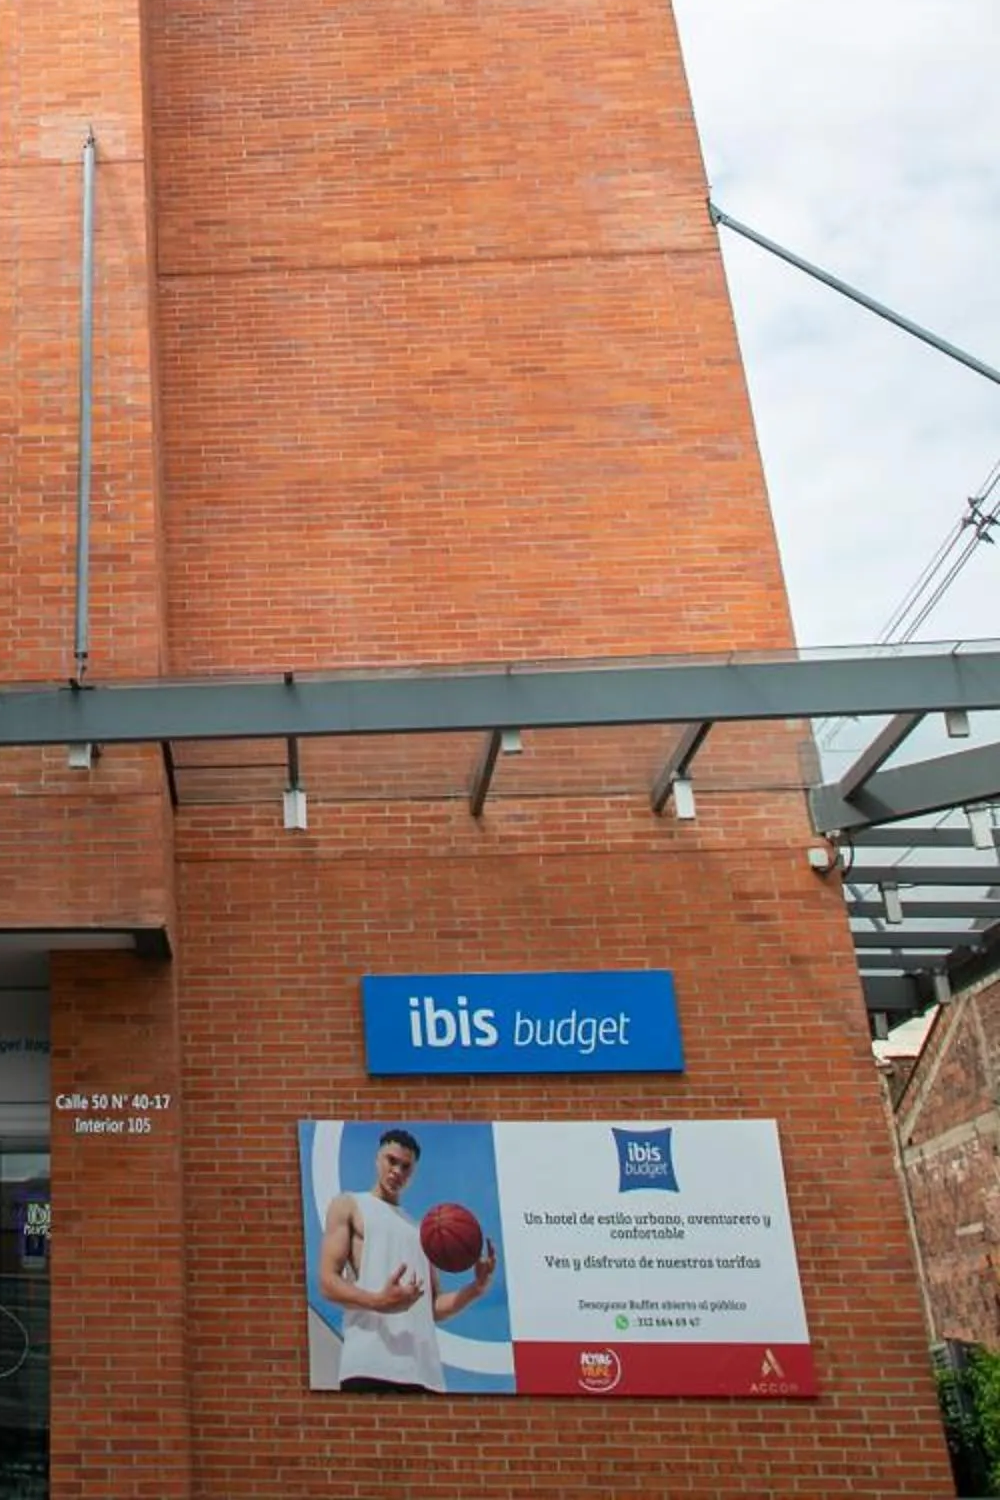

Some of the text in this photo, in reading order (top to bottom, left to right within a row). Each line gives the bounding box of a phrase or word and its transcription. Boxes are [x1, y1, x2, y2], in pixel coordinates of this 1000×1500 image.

[409, 996, 631, 1055] ibis budget
[56, 1094, 88, 1110] Calle
[91, 1094, 108, 1110] 50
[131, 1094, 171, 1110] 40-17
[75, 1117, 151, 1133] Interior 105
[628, 1141, 661, 1161] ibis
[625, 1160, 668, 1178] budget
[523, 1212, 771, 1228] Un hotel de estilo urbano, aventurero y
[610, 1227, 685, 1239] confortable
[544, 1254, 761, 1271] Ven y disfruta de nuestras tarifas
[749, 1382, 800, 1395] ACCOR
